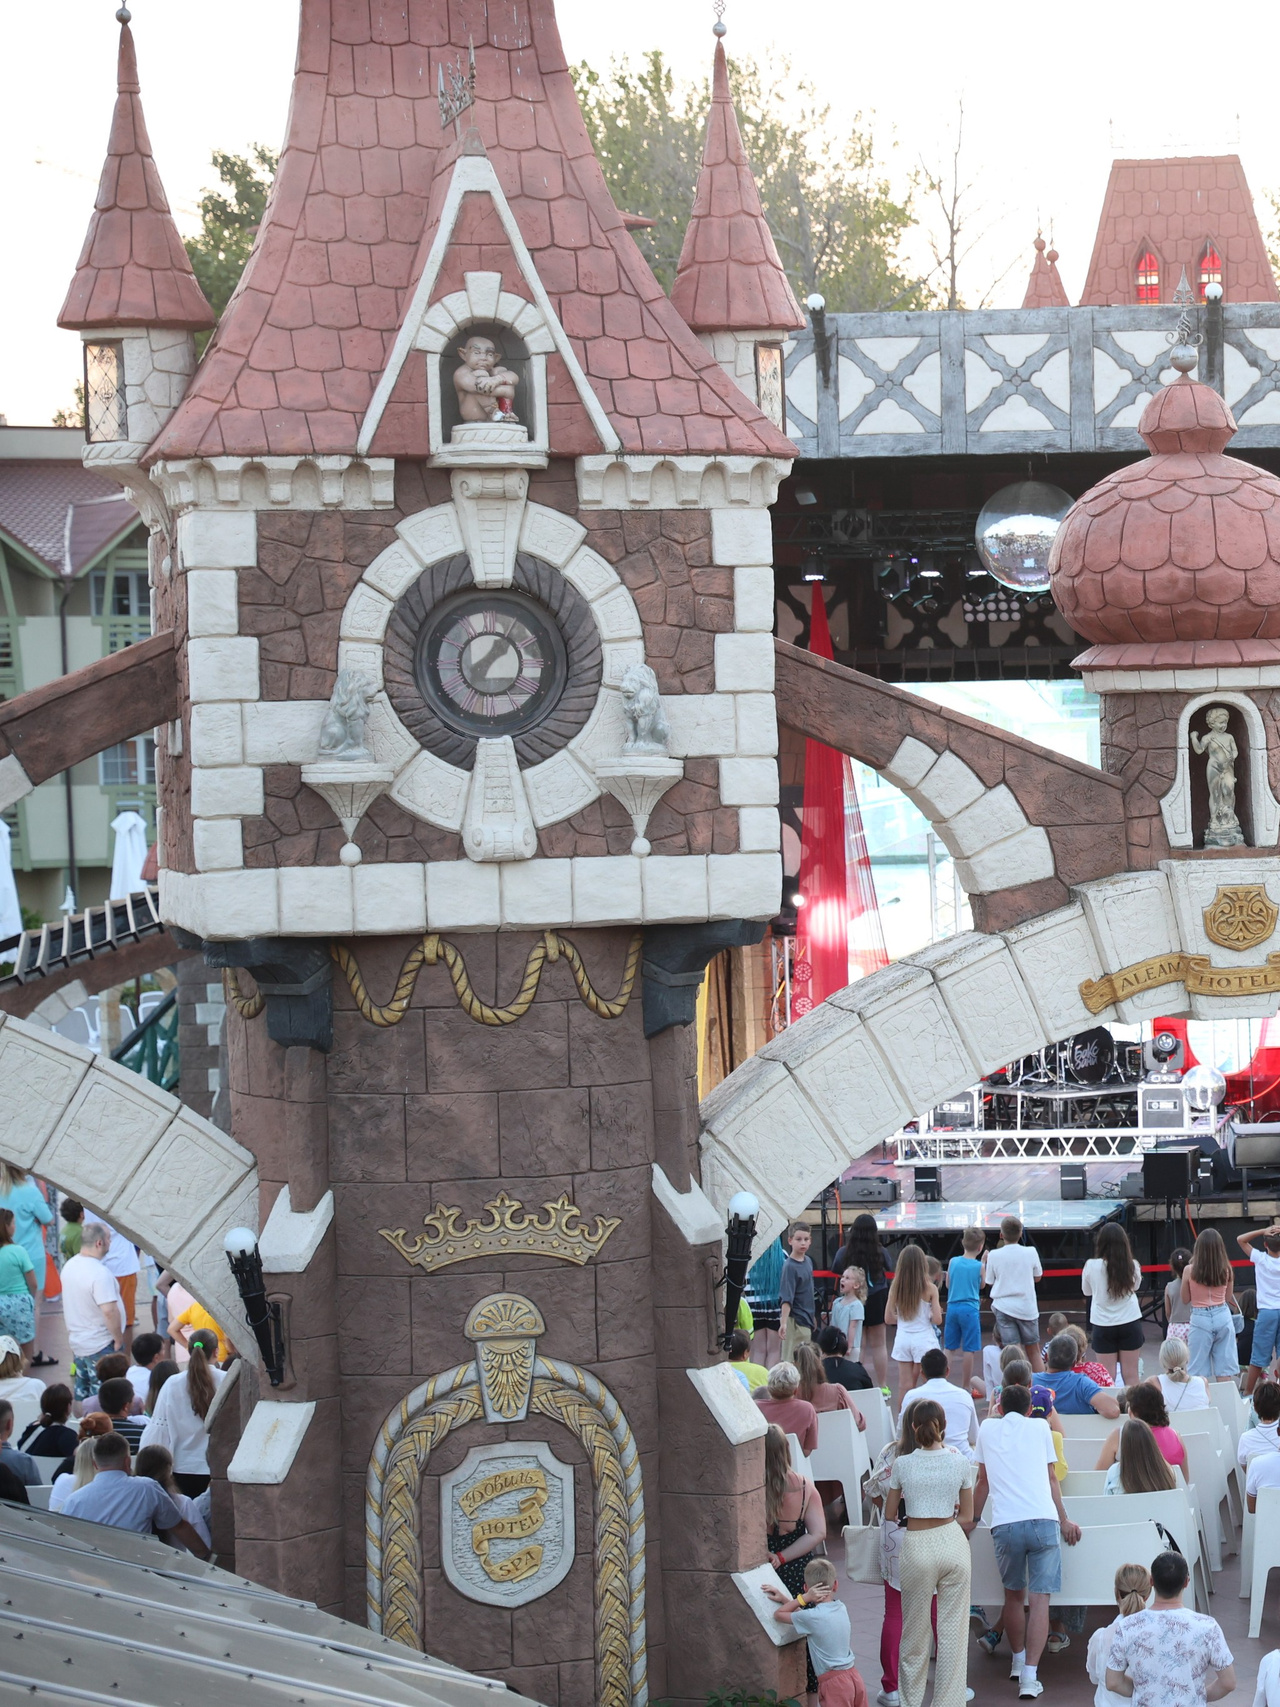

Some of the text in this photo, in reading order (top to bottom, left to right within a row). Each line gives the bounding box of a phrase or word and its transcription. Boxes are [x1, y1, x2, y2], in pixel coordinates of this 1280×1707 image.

[1120, 961, 1181, 992] ALEAN
[1199, 974, 1276, 989] HOTEL
[462, 1471, 539, 1508] Довиль
[480, 1514, 540, 1536] HOTEL
[499, 1550, 536, 1577] SPA
